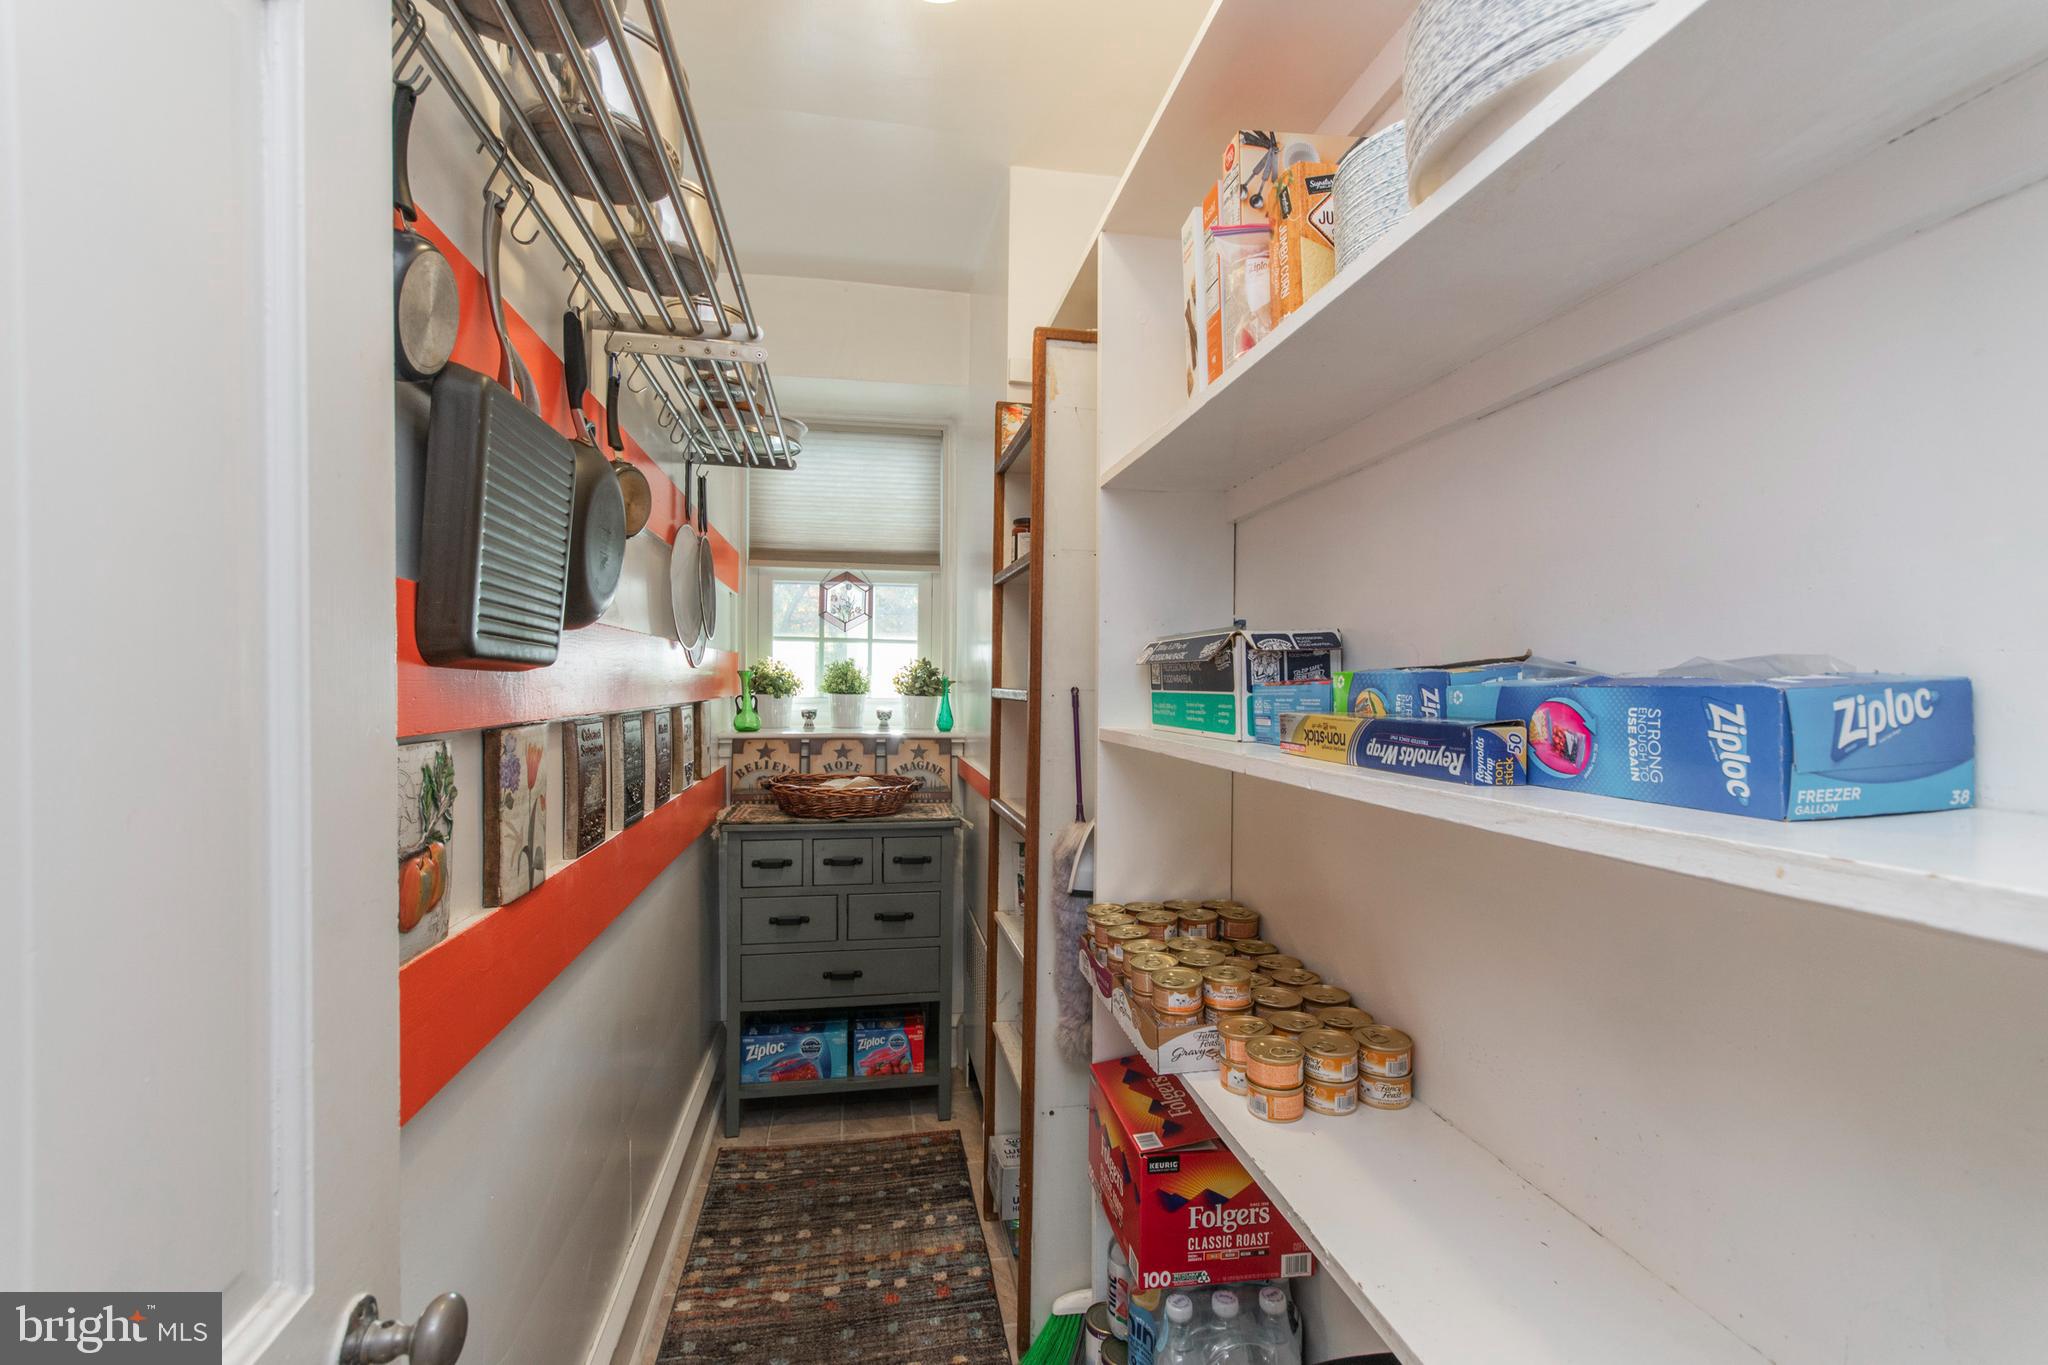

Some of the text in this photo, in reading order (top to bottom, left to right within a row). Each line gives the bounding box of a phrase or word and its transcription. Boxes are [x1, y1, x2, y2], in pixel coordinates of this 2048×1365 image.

[1421, 687, 1440, 719] Zip
[1832, 687, 1934, 750] Ziploc
[1507, 733, 1522, 755] 50
[1628, 707, 1640, 782] USE AGAIN
[1637, 707, 1650, 782] ENOUGH TO
[1647, 707, 1663, 784] STRONG
[1706, 702, 1750, 799] Ziploc
[822, 760, 863, 773] HOPE
[1365, 737, 1465, 776] Reynolds Wrap
[1475, 736, 1485, 783] Reynolds
[893, 760, 946, 777] IMAGINE
[1484, 757, 1495, 785] Wrap
[1505, 757, 1515, 785] stick
[1797, 786, 1862, 804] FREEZER
[1949, 789, 1970, 805] 38
[1794, 802, 1839, 816] GALLON
[745, 1041, 785, 1062] Ziploc
[857, 1035, 886, 1050] Ziploc
[1171, 1046, 1207, 1063] Gravy
[1151, 1075, 1192, 1118] Folgers
[1377, 1084, 1402, 1094] Fancy
[1149, 1161, 1179, 1170] KEURIG
[1188, 1203, 1270, 1233] Folgers
[1187, 1232, 1270, 1251] CLASSIC ROAST
[1143, 1270, 1172, 1289] 100
